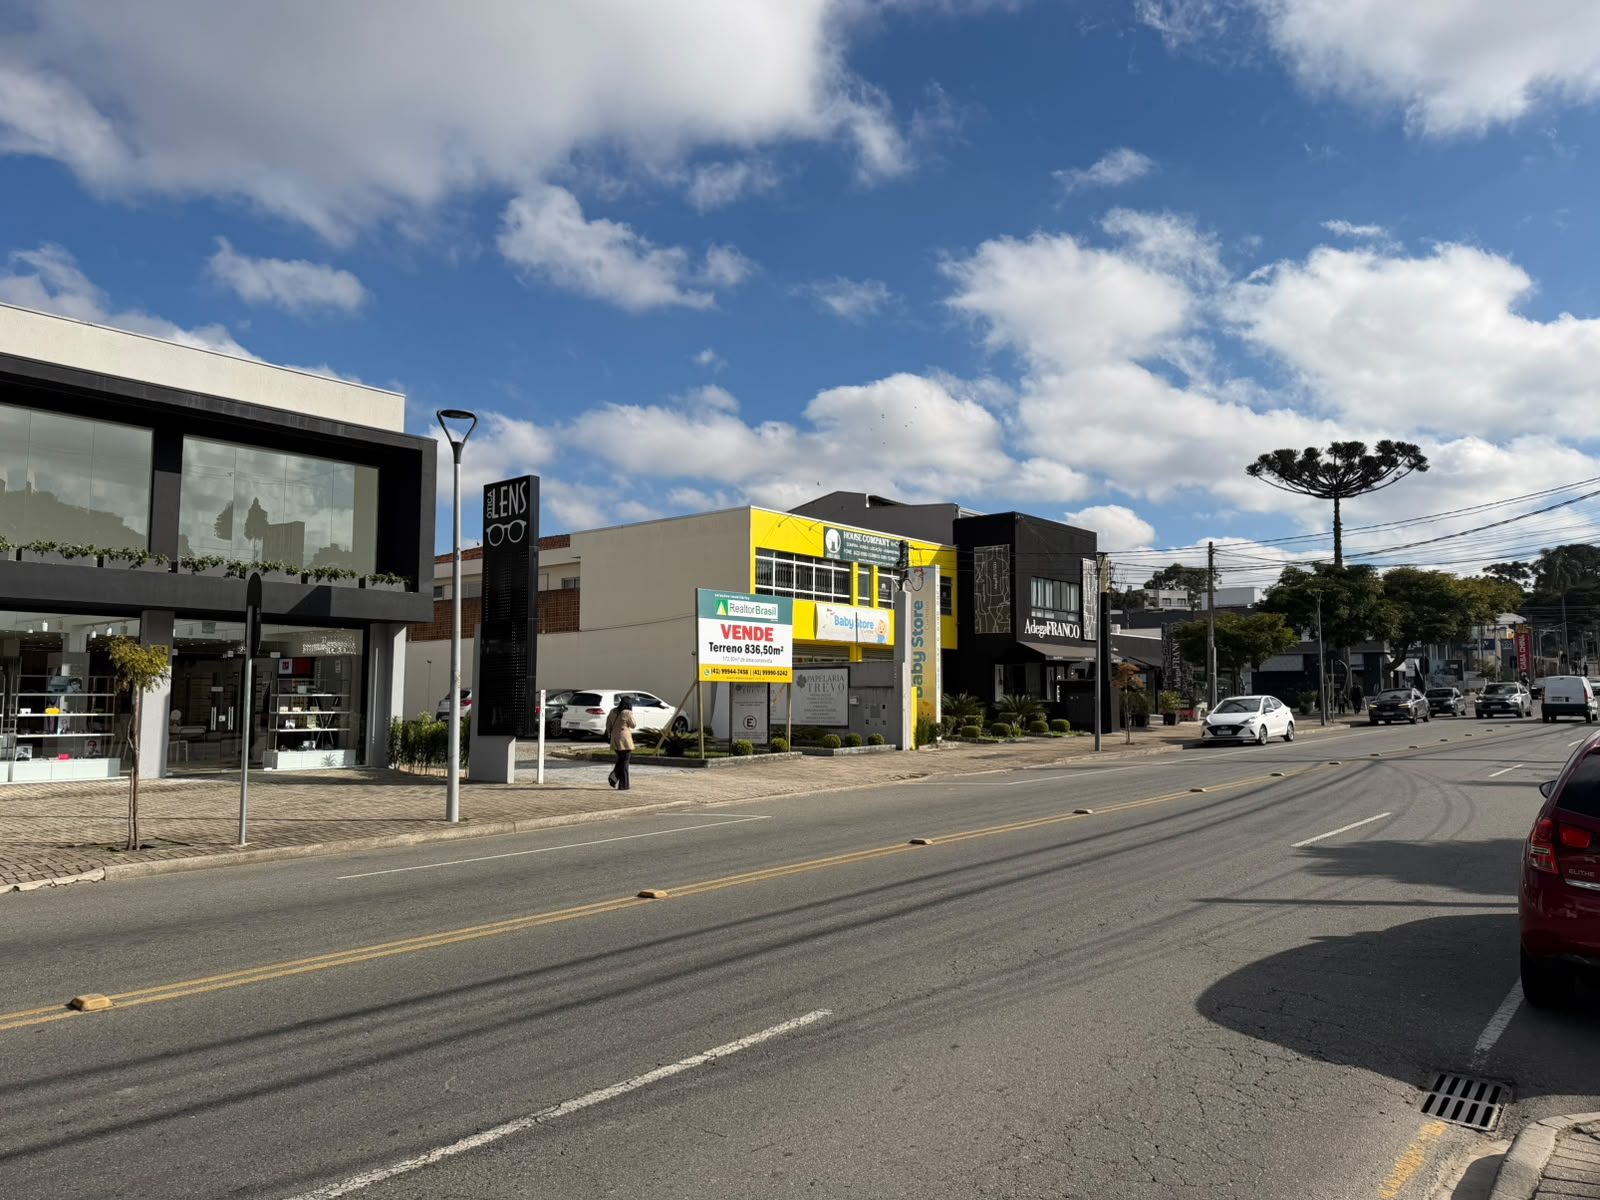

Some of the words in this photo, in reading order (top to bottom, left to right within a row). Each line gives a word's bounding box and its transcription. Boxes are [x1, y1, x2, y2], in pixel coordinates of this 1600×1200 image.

[492, 481, 526, 519] LENS
[844, 531, 862, 541] HOUSE
[862, 535, 890, 547] COMPANY
[834, 615, 854, 629] Baby
[911, 600, 924, 648] Store
[720, 623, 774, 642] VENDE
[709, 642, 743, 653] Terreno
[744, 644, 784, 656] 836,50m²
[807, 673, 845, 682] PAPELARIA
[807, 682, 845, 693] TREVO
[746, 718, 754, 728] E
